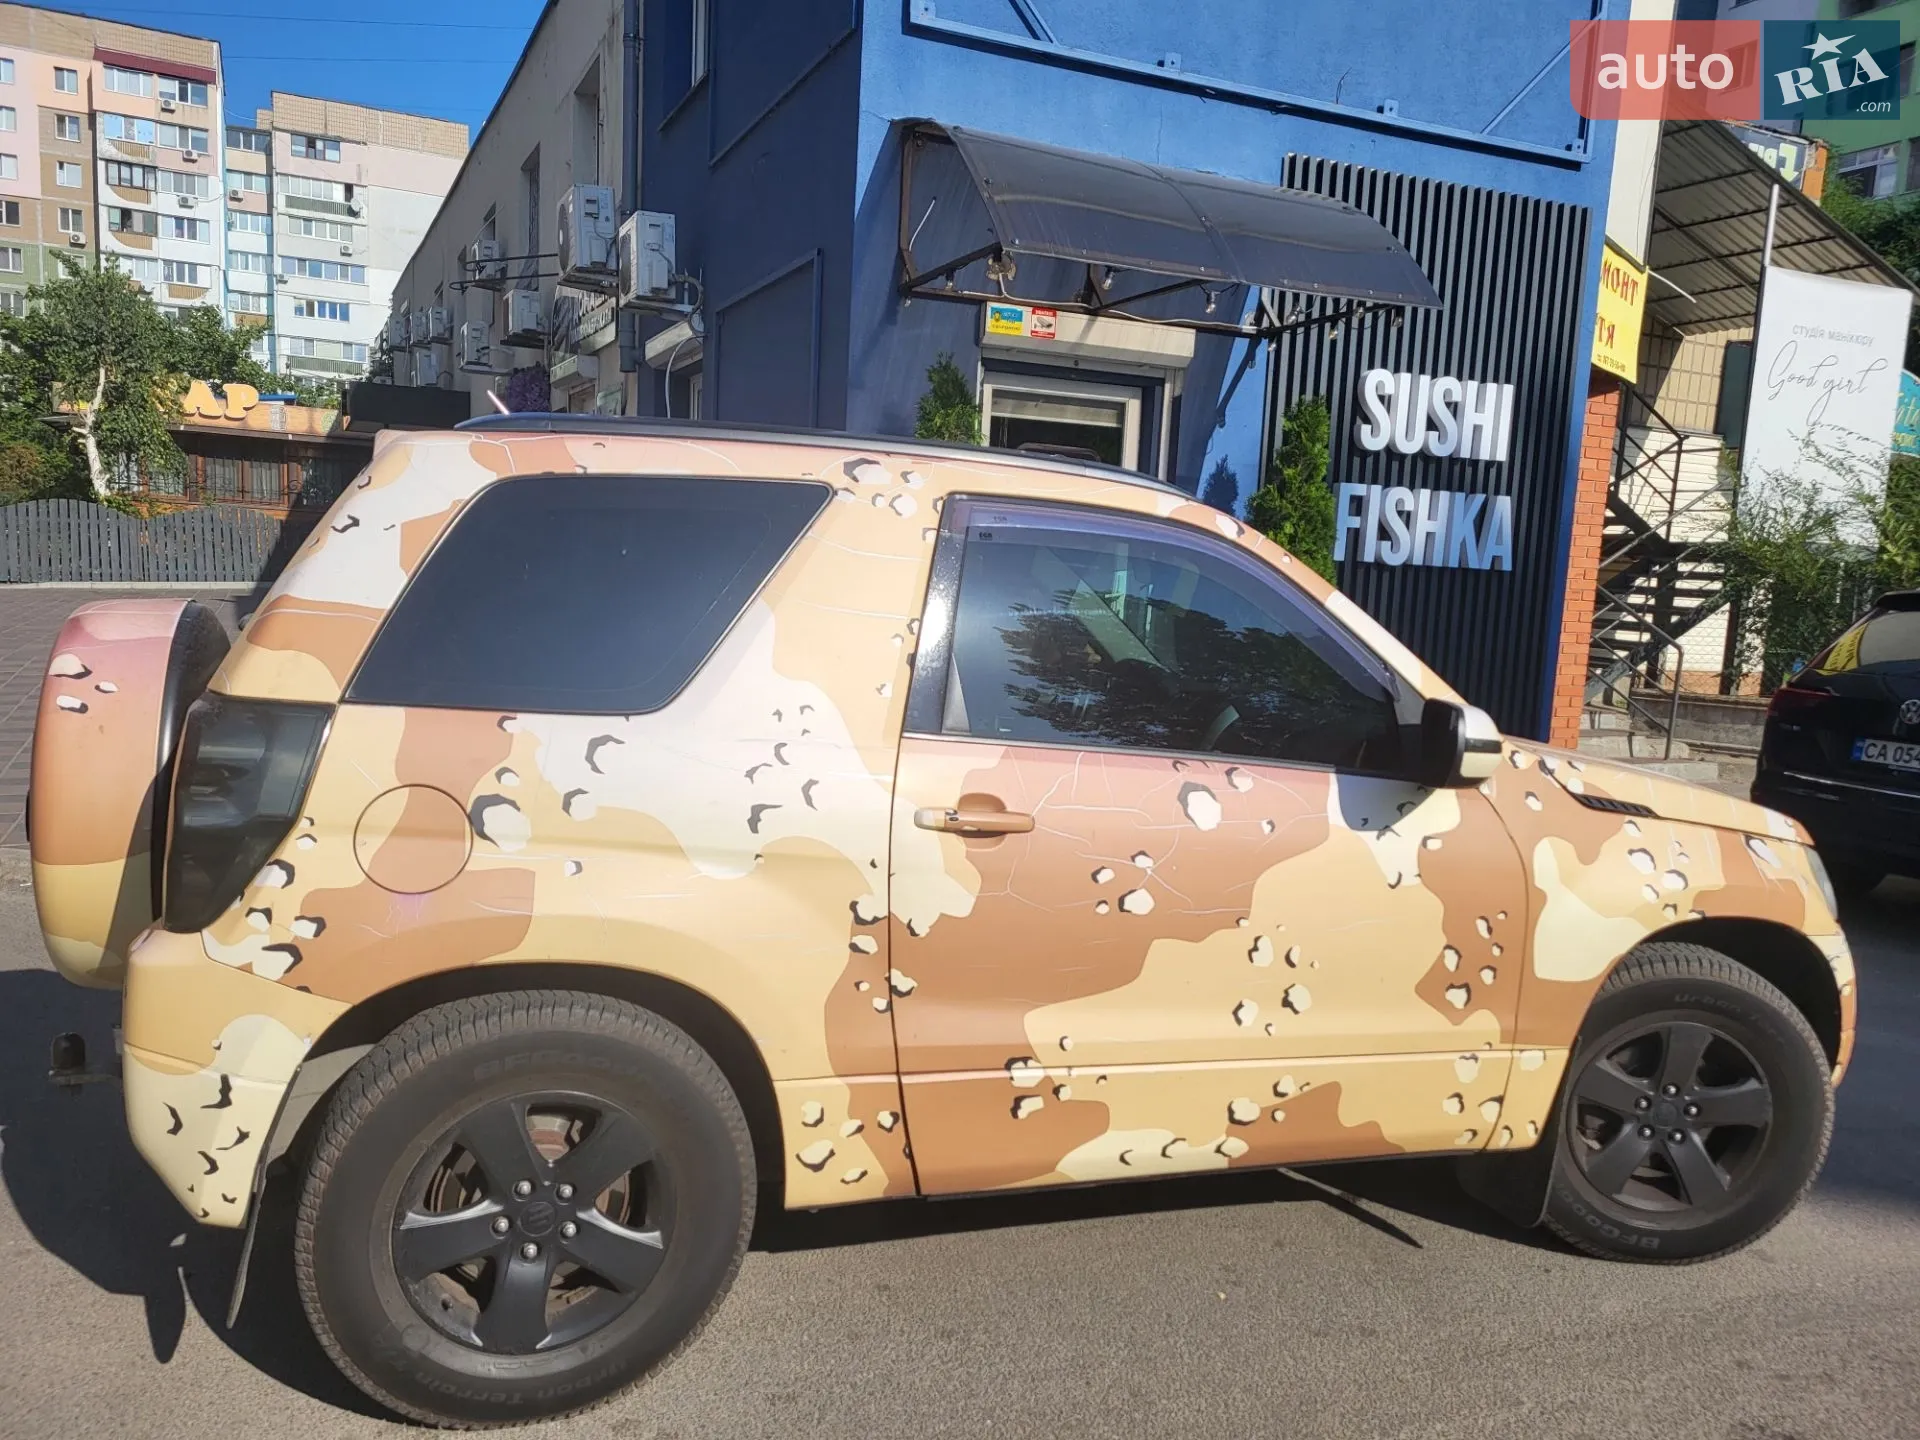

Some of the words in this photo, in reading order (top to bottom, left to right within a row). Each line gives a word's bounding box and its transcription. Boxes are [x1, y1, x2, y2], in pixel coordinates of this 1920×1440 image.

[1595, 311, 1616, 348] ТЯ
[155, 378, 260, 421] АР
[1354, 368, 1514, 462] SUSHI
[1767, 339, 1839, 401] Good
[1806, 357, 1889, 427] girl
[1334, 482, 1514, 572] FISHKA
[1864, 742, 1889, 763] CA
